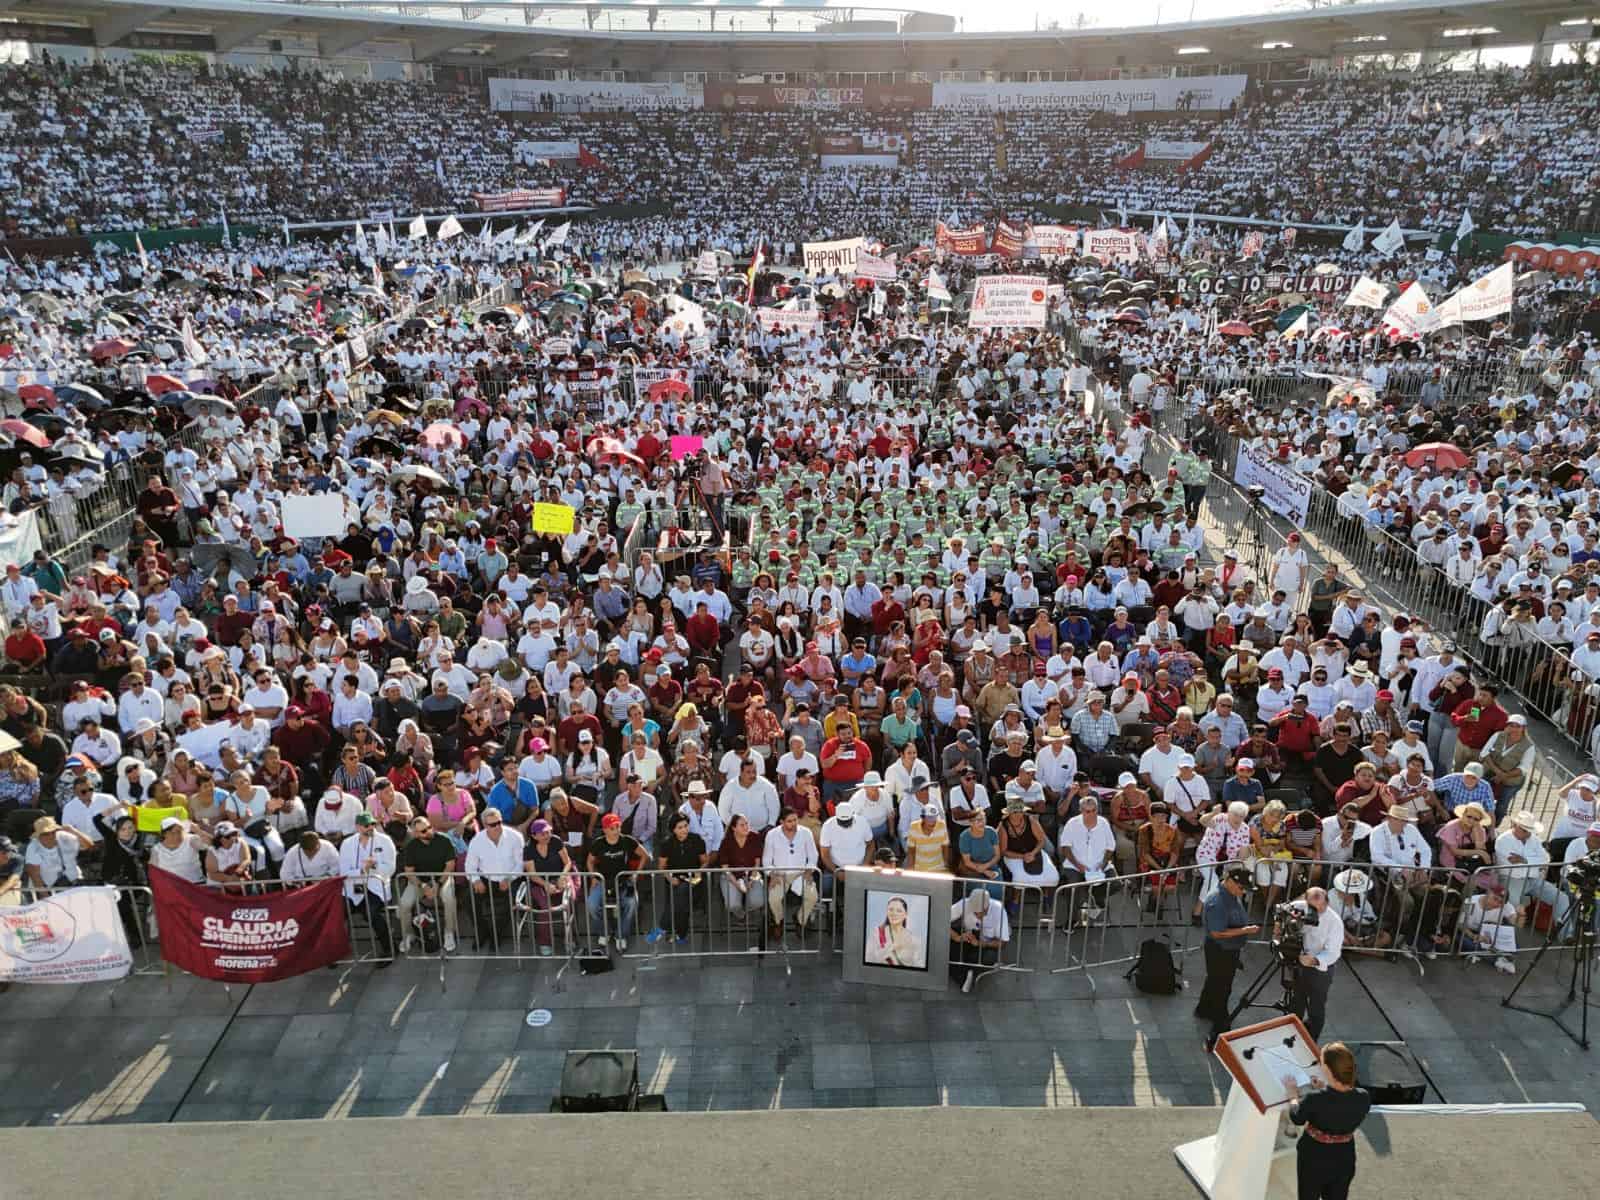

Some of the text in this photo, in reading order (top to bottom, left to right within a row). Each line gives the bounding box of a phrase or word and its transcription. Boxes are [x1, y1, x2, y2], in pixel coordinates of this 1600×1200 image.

[774, 88, 864, 104] VERACRUZ
[998, 94, 1011, 104] La
[1016, 92, 1110, 105] Transformación
[1114, 91, 1155, 103] Avanza
[1091, 237, 1130, 246] morena
[202, 917, 299, 935] CLAUDIA
[215, 958, 258, 968] morena
